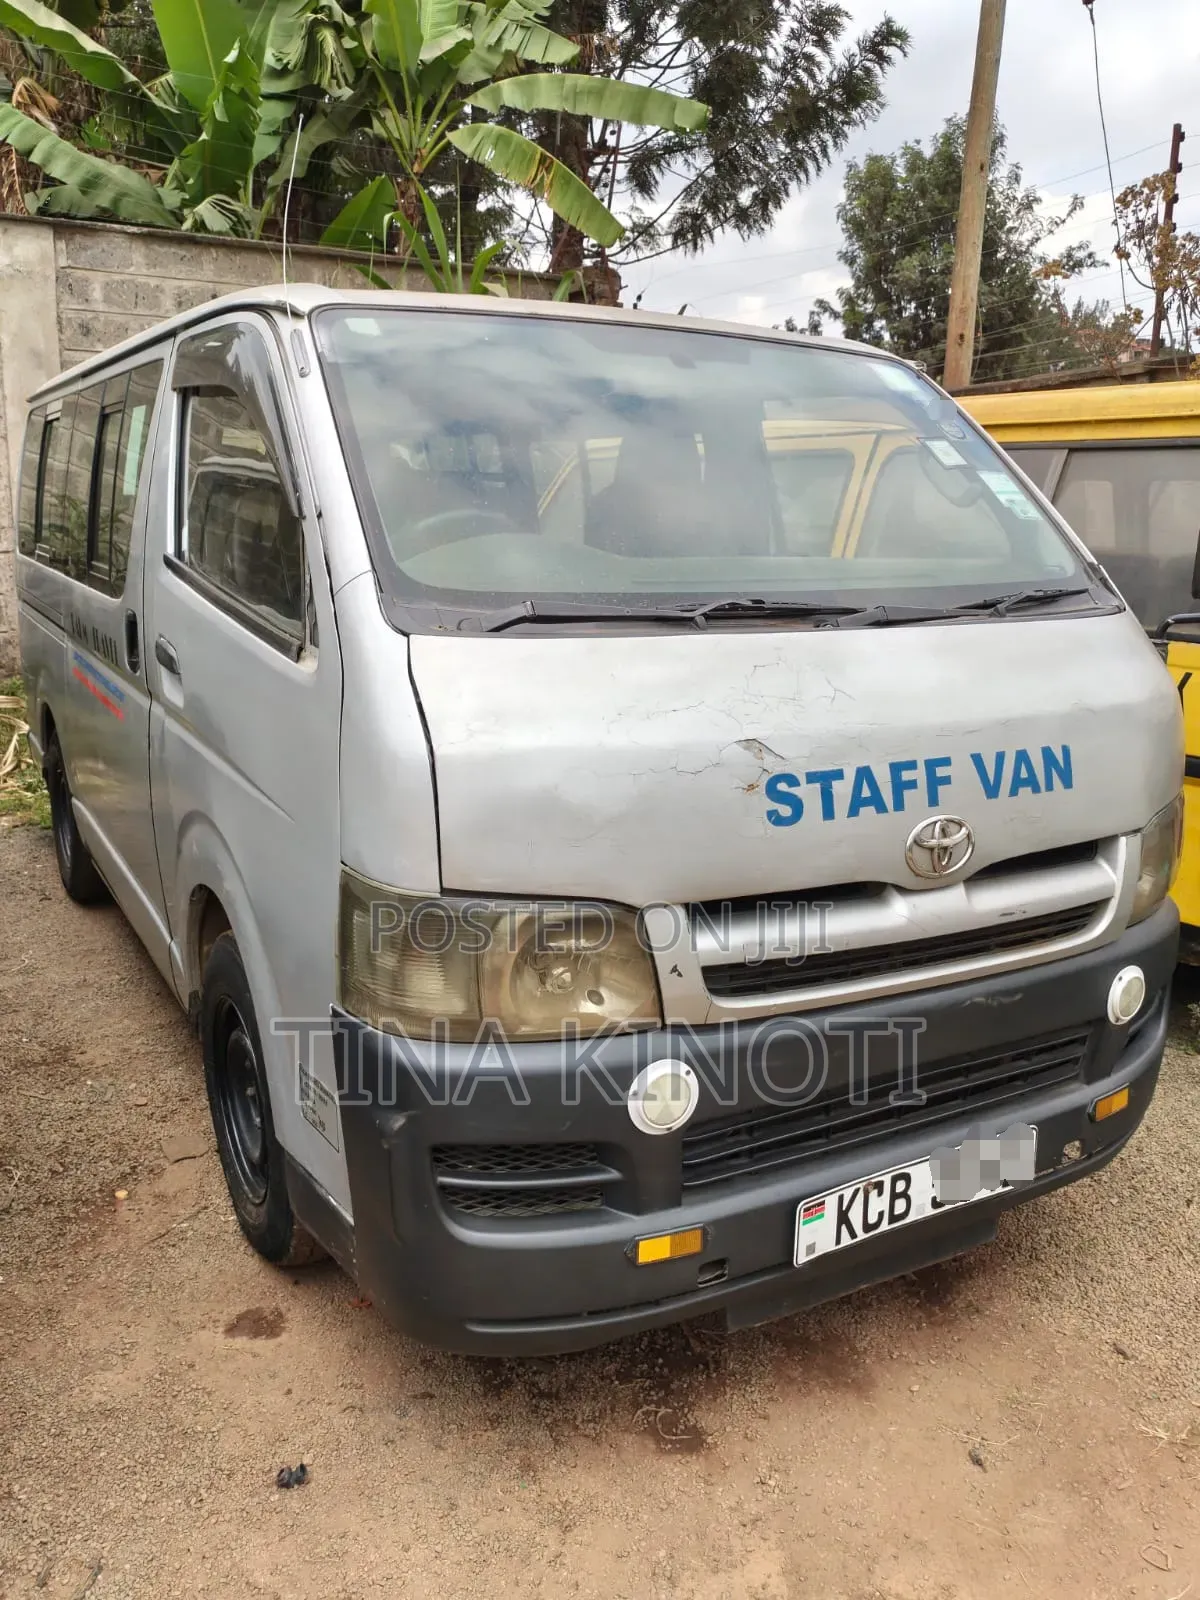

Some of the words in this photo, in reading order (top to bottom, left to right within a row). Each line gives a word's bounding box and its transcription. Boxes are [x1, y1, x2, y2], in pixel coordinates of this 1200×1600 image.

[765, 756, 952, 827] STAFF
[970, 744, 1074, 800] VAN
[835, 1171, 912, 1247] KCB
